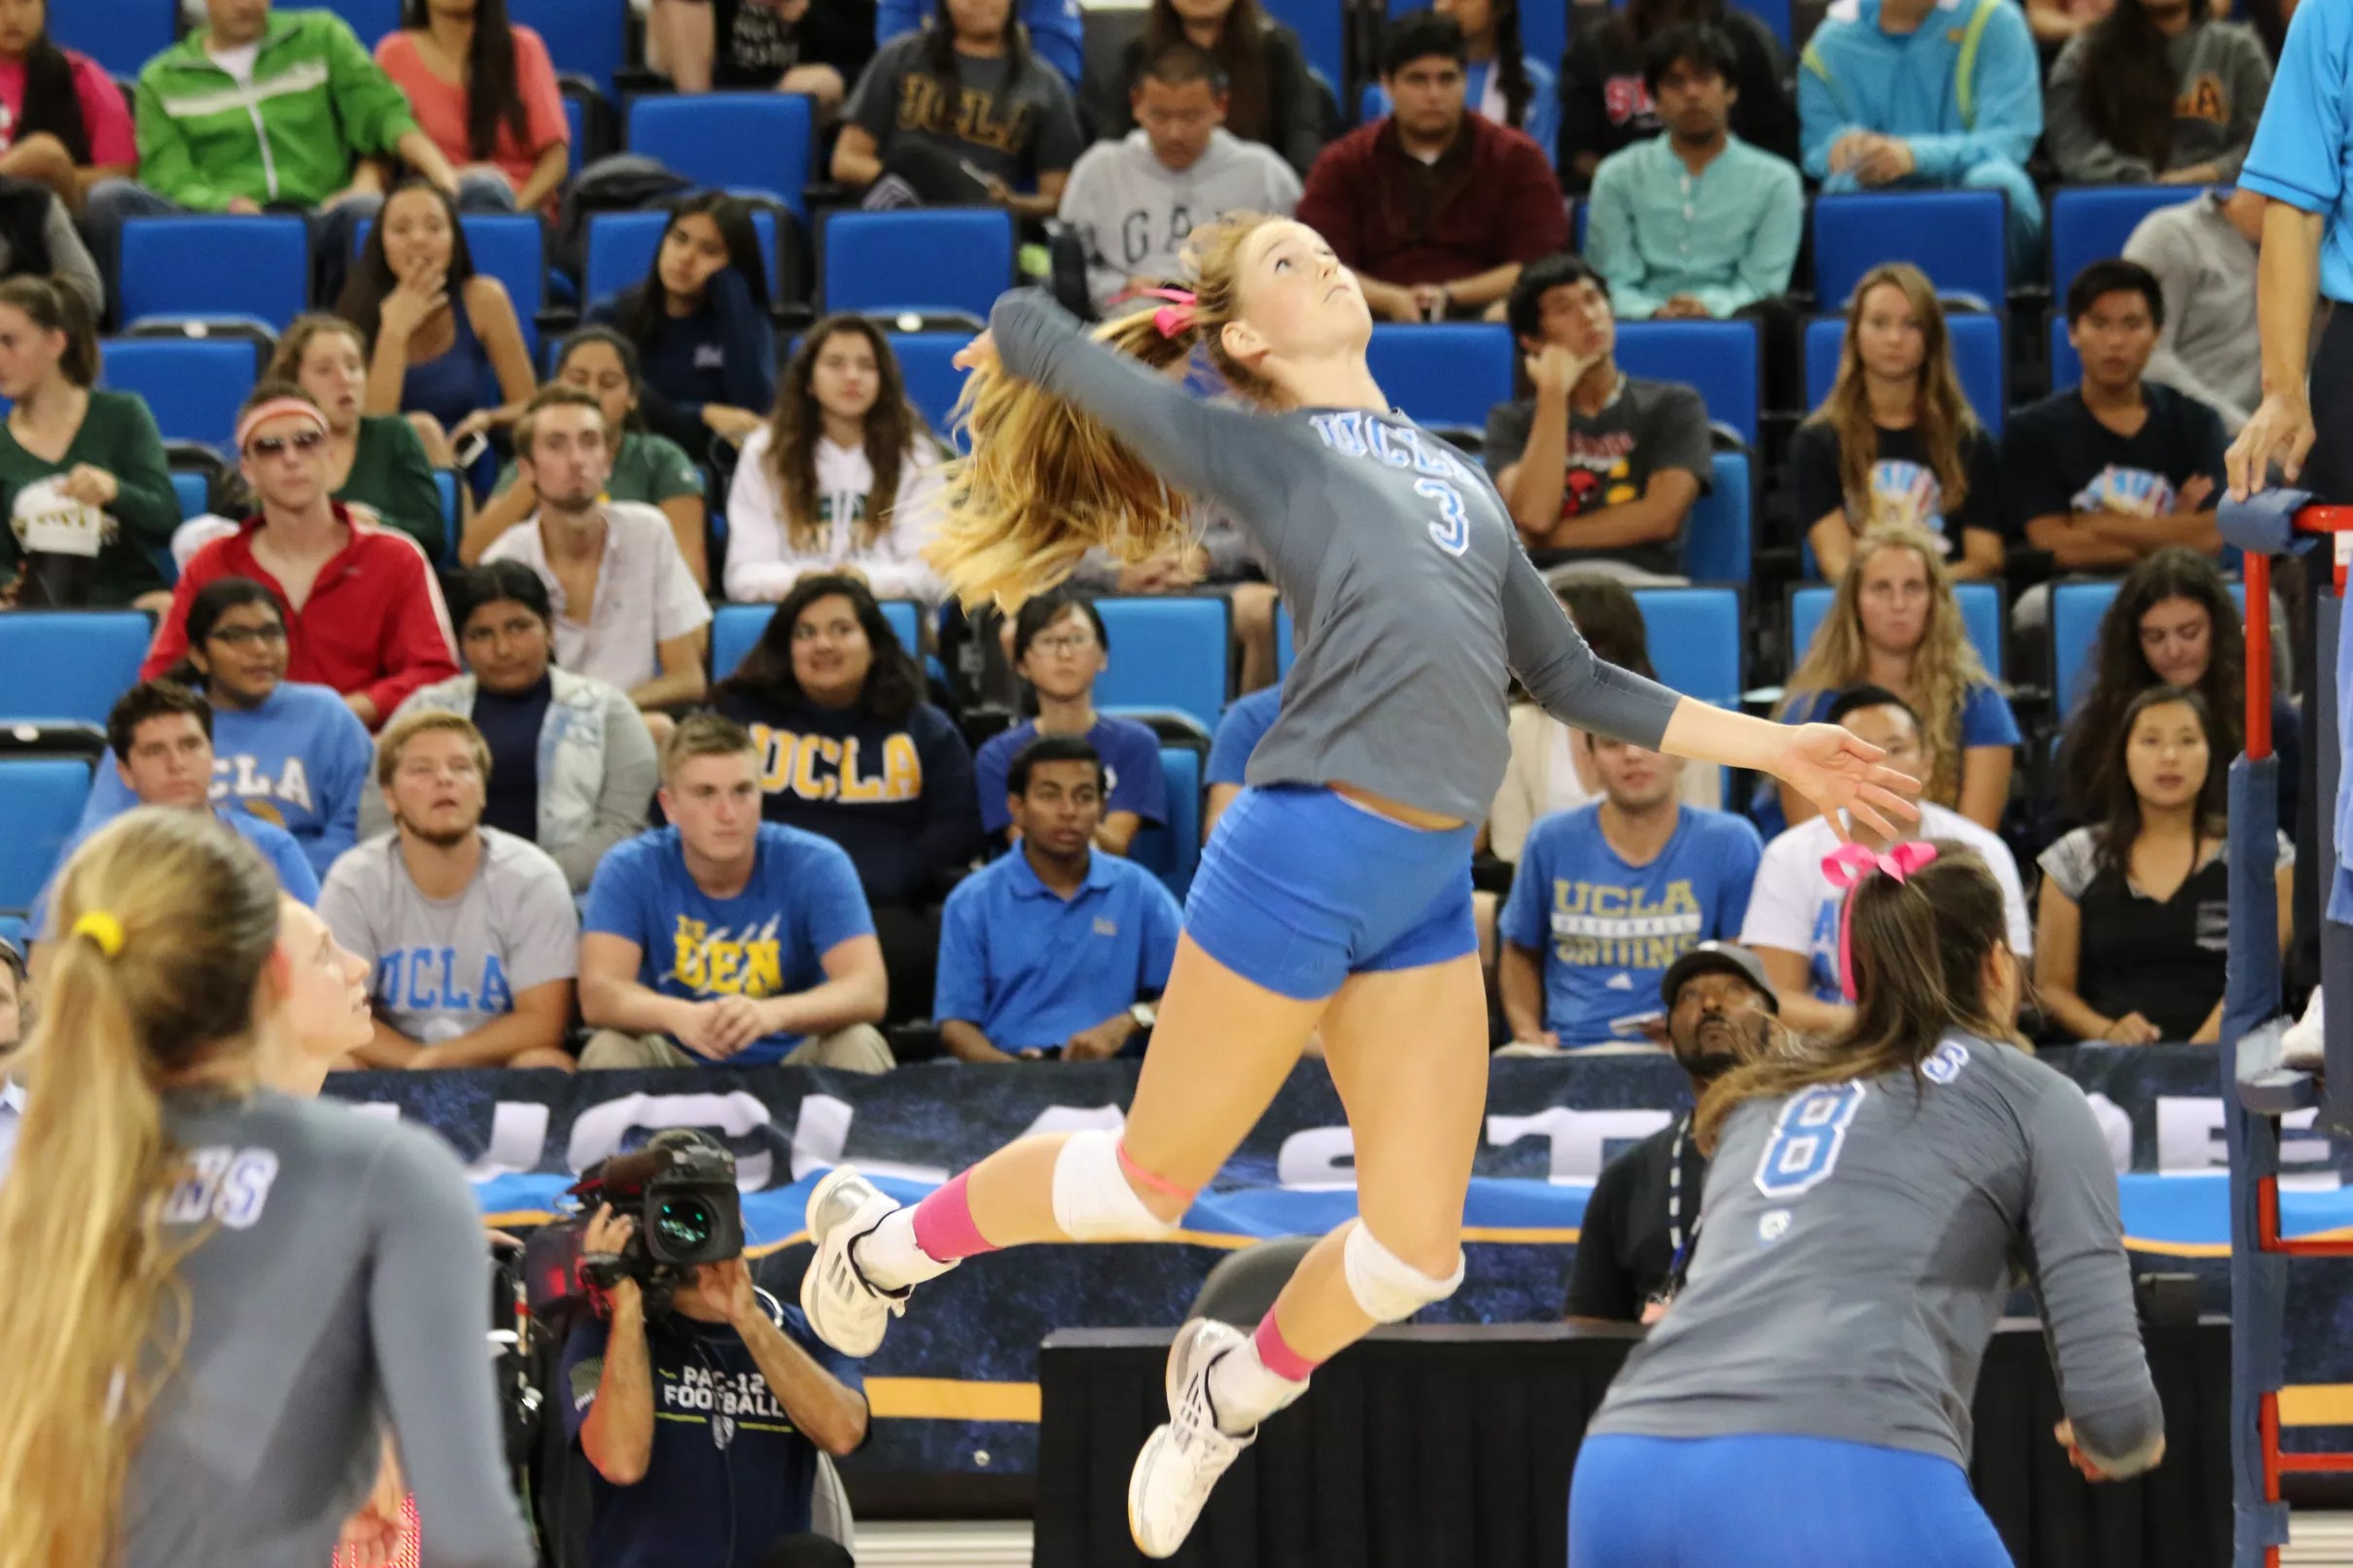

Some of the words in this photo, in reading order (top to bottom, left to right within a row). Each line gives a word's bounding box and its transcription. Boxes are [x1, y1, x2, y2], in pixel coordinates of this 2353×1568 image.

[1414, 476, 1470, 556] 3
[749, 722, 923, 803] UCLA
[1554, 878, 1698, 918] UCLA
[674, 931, 784, 998] DEN
[1753, 1077, 1867, 1200] 8
[683, 1365, 766, 1396] PAC-12
